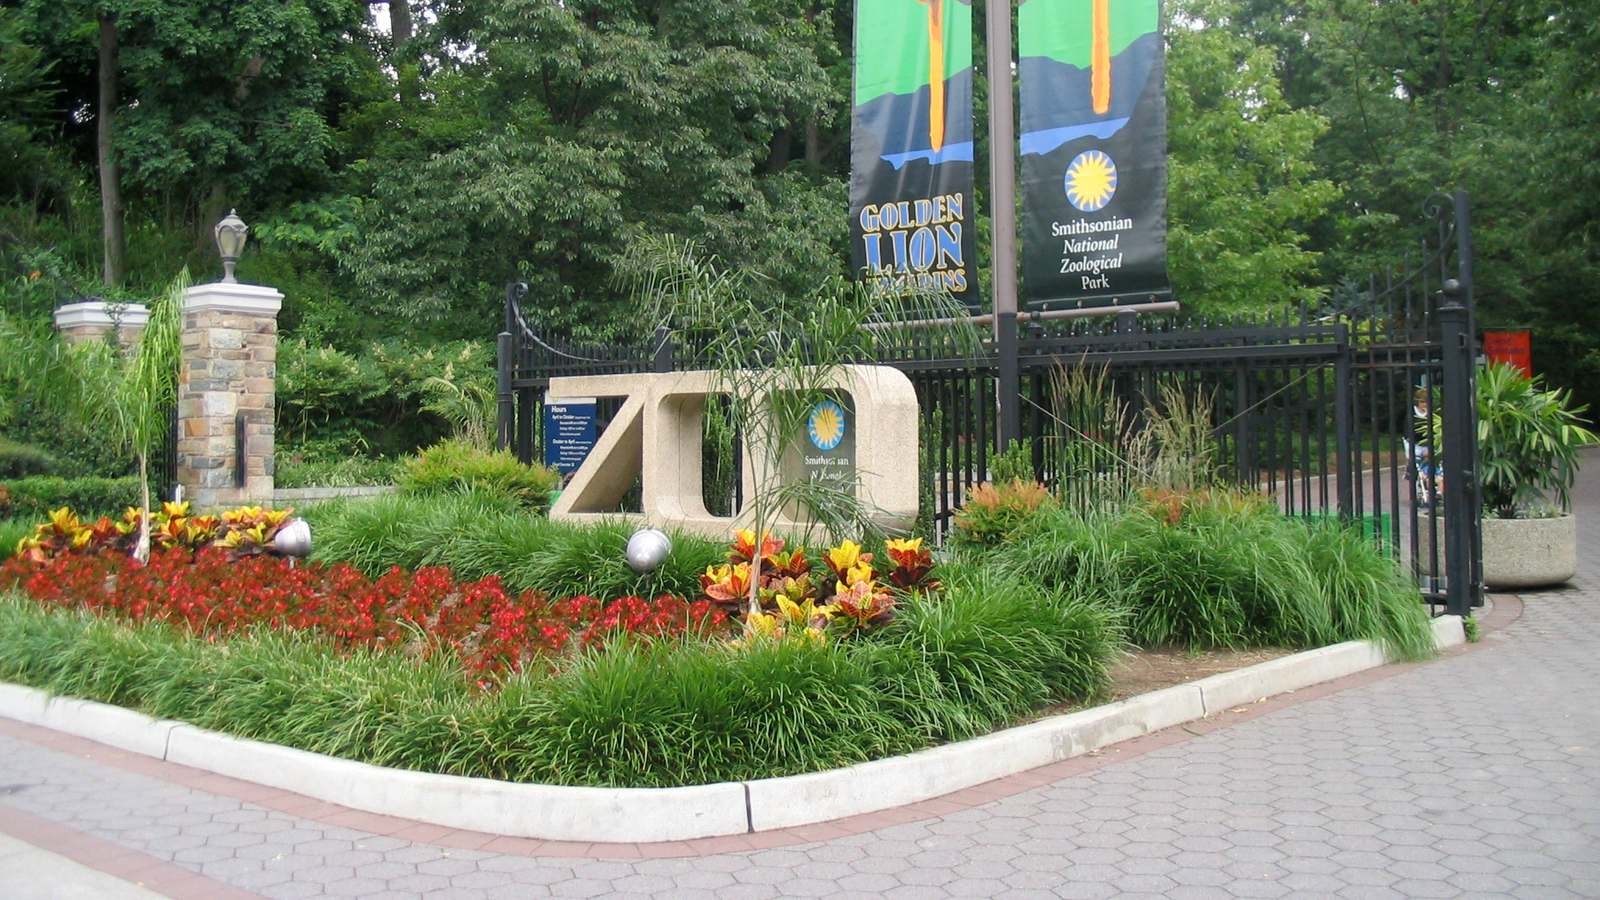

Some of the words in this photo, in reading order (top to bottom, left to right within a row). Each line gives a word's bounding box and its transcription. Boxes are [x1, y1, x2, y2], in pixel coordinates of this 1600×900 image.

[860, 192, 964, 233] GOLDEN
[1051, 215, 1133, 237] Smithsonian
[862, 221, 965, 276] LION
[1062, 233, 1120, 254] National
[1060, 252, 1123, 275] Zoological
[1081, 273, 1110, 290] Park
[549, 364, 919, 538] ZOO
